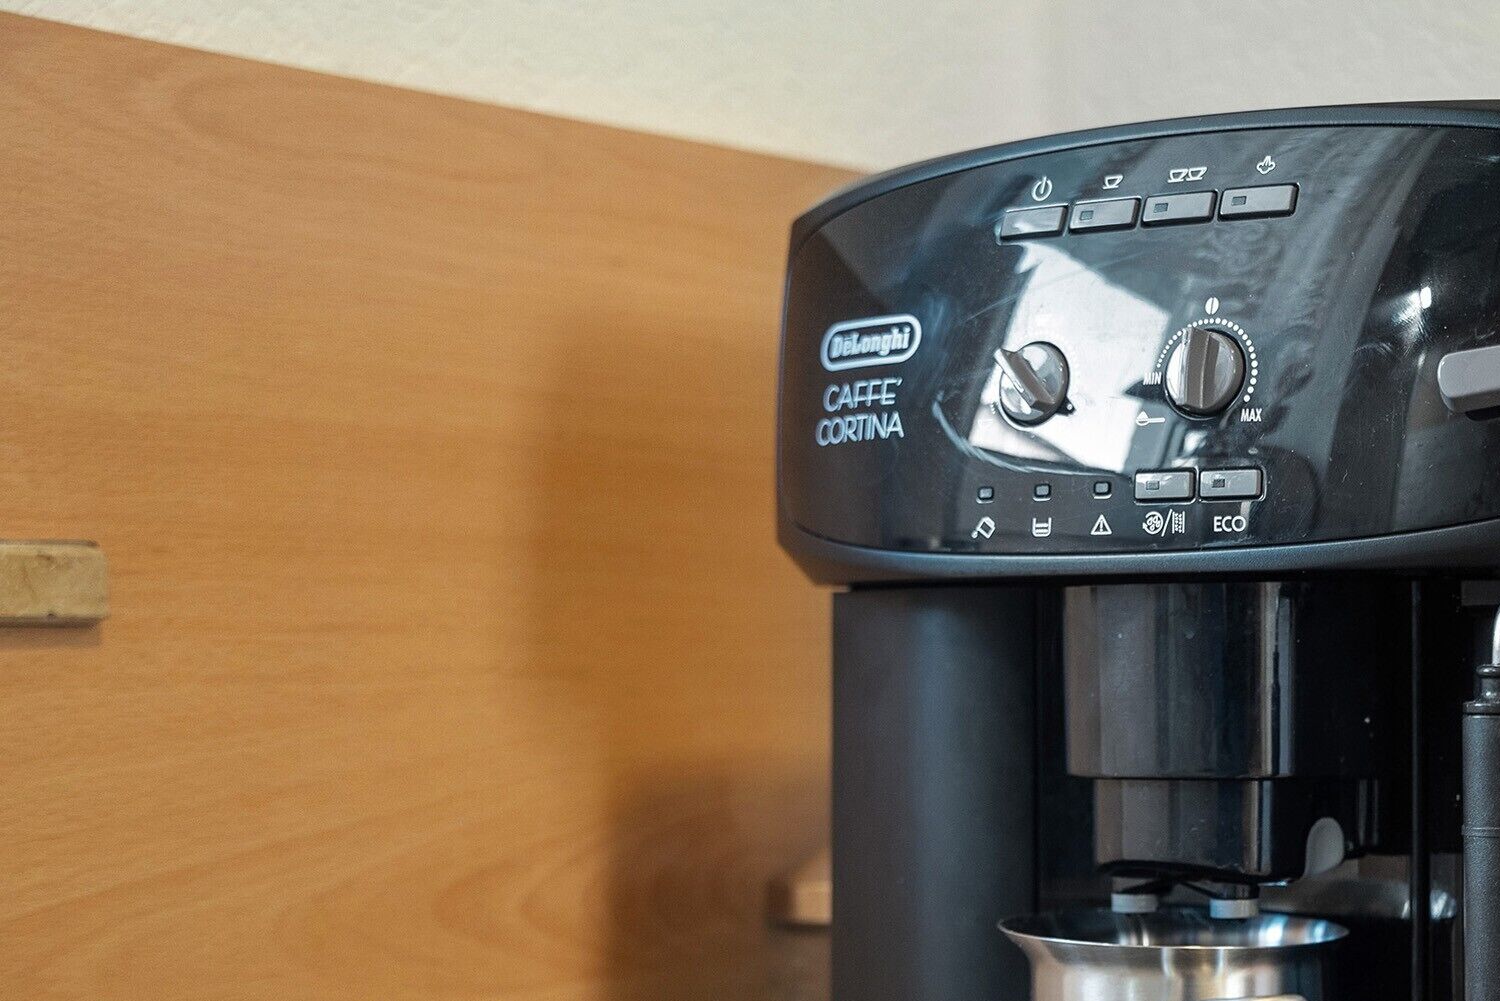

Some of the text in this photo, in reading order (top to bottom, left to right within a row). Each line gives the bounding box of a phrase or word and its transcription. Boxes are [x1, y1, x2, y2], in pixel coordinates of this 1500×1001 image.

[1143, 372, 1162, 386] MIN
[1240, 408, 1263, 422] MAX
[815, 411, 905, 447] CORTINA
[1213, 515, 1247, 533] ECO
